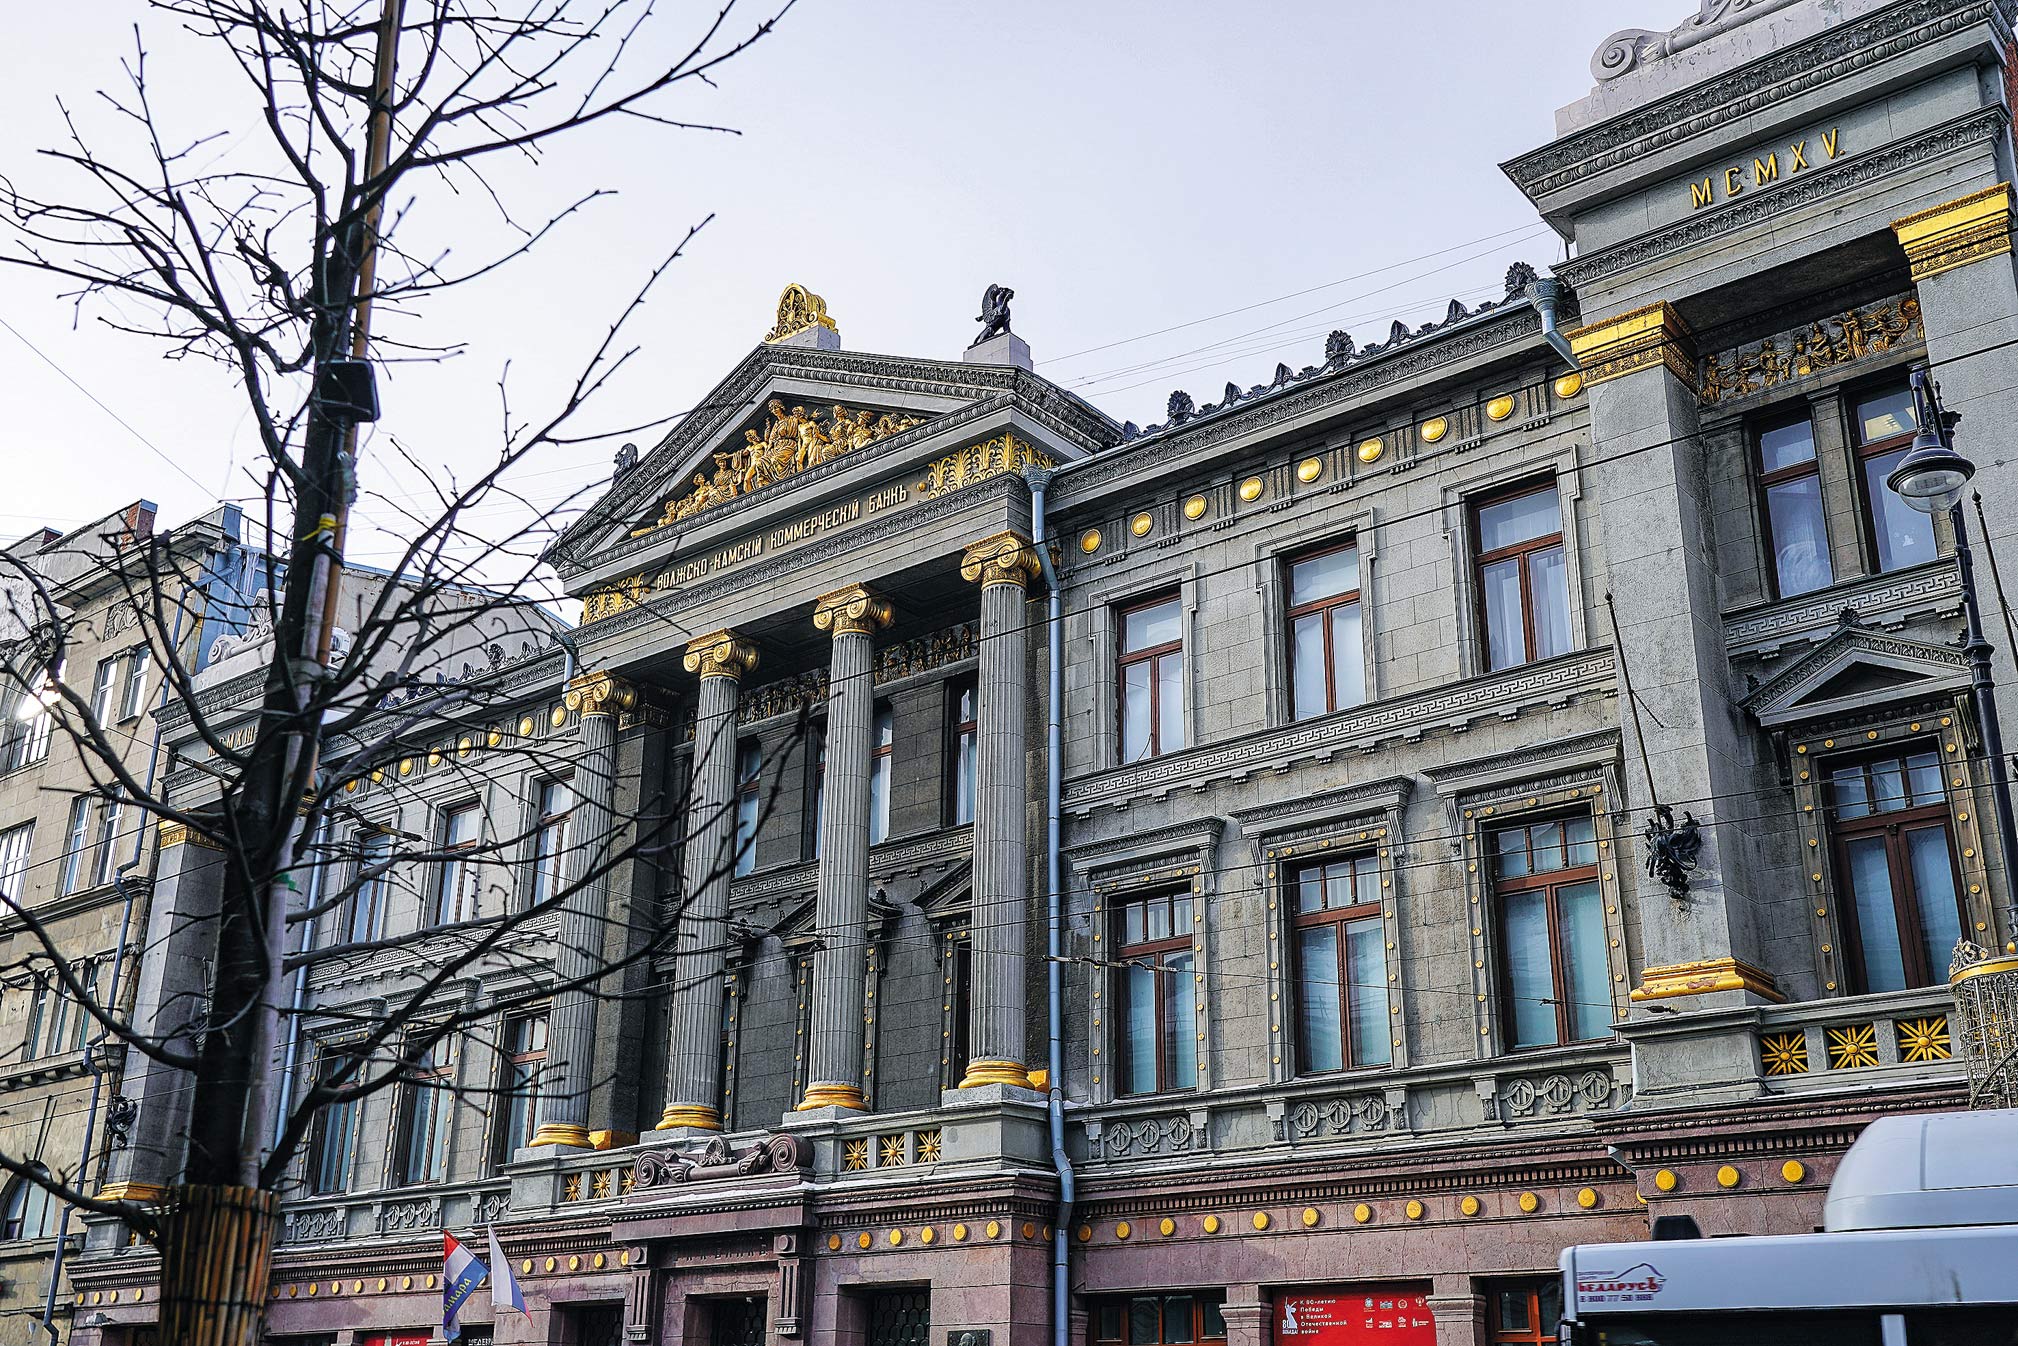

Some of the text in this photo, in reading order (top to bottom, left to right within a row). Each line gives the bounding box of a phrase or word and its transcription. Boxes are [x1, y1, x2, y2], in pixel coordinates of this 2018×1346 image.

[770, 498, 861, 550] КОММЕРЧЕСКІЙ
[868, 484, 908, 514] БАНКЪ
[1577, 1276, 1658, 1292] БЕЛАРУСЬ
[1301, 1319, 1347, 1327] Отечественной
